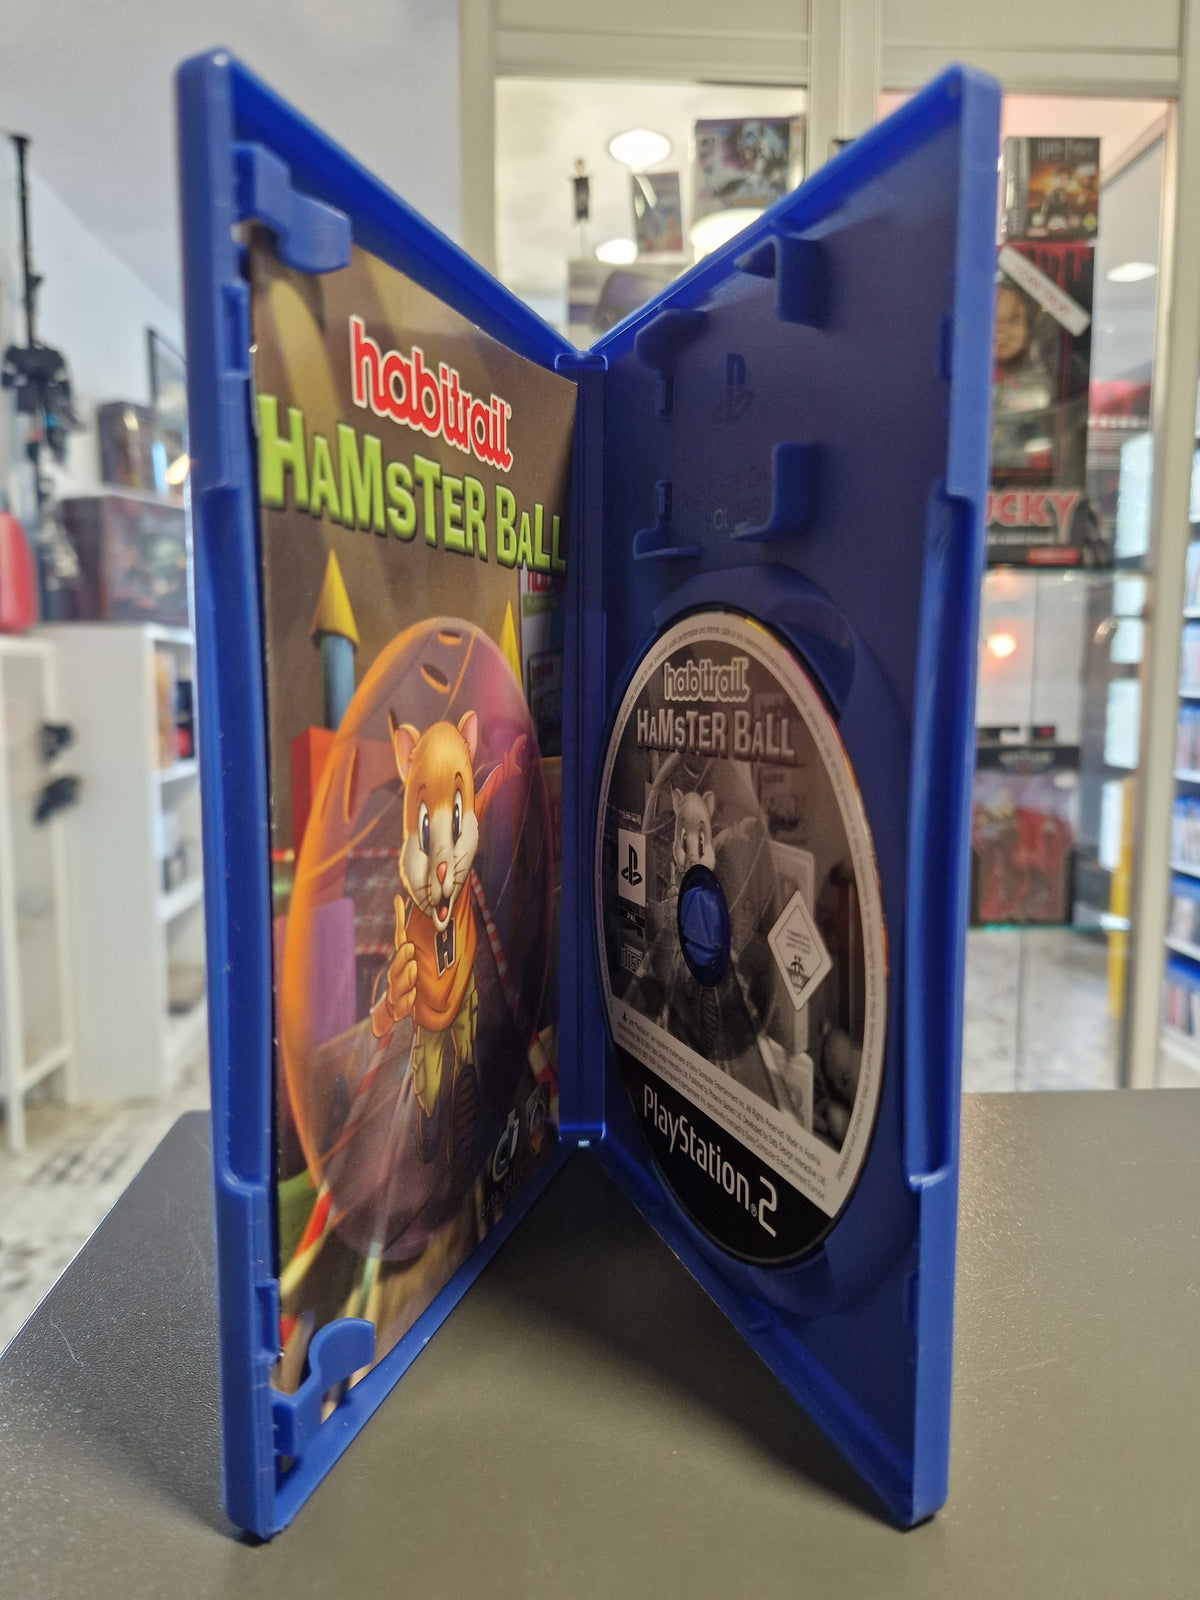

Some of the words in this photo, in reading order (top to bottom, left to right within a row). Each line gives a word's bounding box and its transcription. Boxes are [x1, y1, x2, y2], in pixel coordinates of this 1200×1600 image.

[350, 315, 512, 472] habitrail
[663, 656, 750, 702] habitrail
[626, 912, 637, 923] PAL
